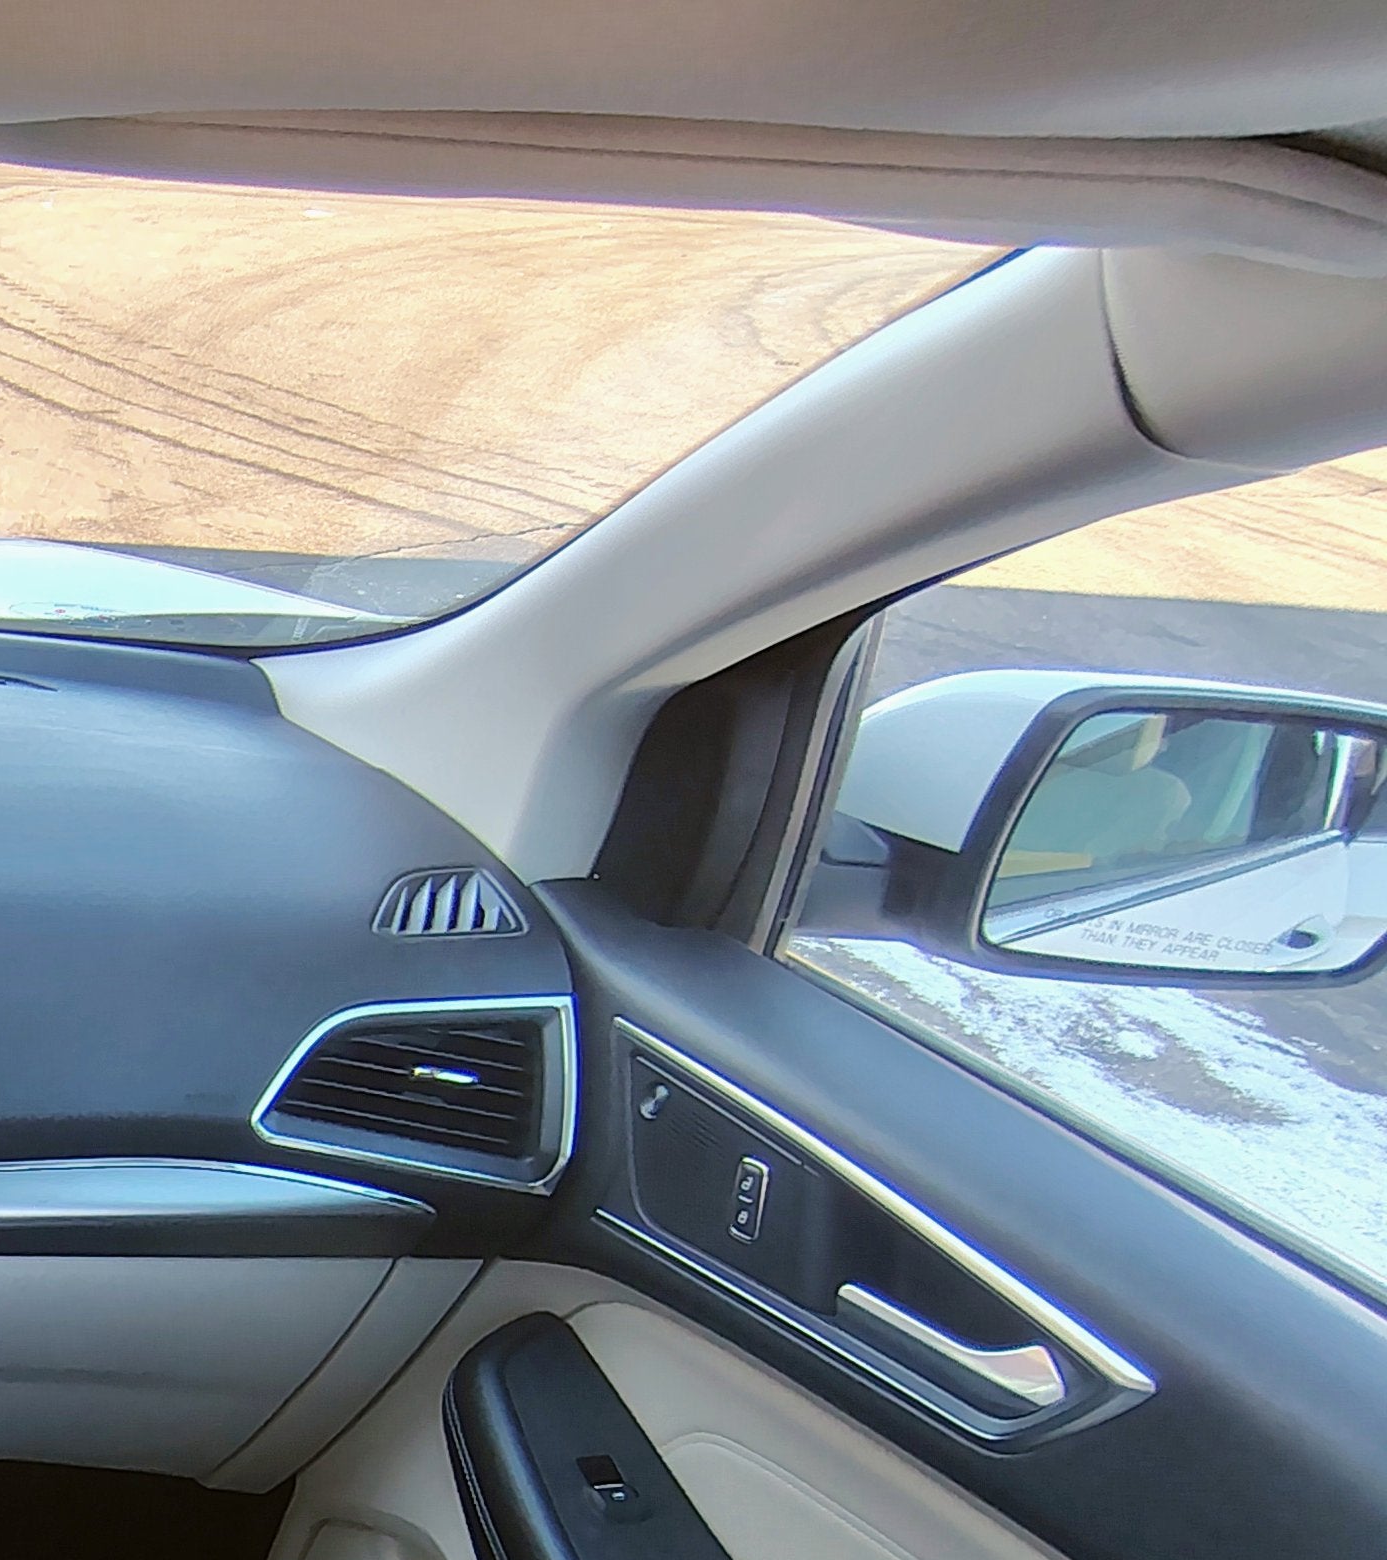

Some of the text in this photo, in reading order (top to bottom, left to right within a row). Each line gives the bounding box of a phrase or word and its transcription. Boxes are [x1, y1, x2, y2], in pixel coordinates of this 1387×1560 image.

[1080, 928, 1221, 962] THAN THEY APPEAR
[1127, 921, 1179, 943] MIRROR
[1183, 931, 1214, 947] ARE
[1216, 938, 1274, 956] CLOSER
